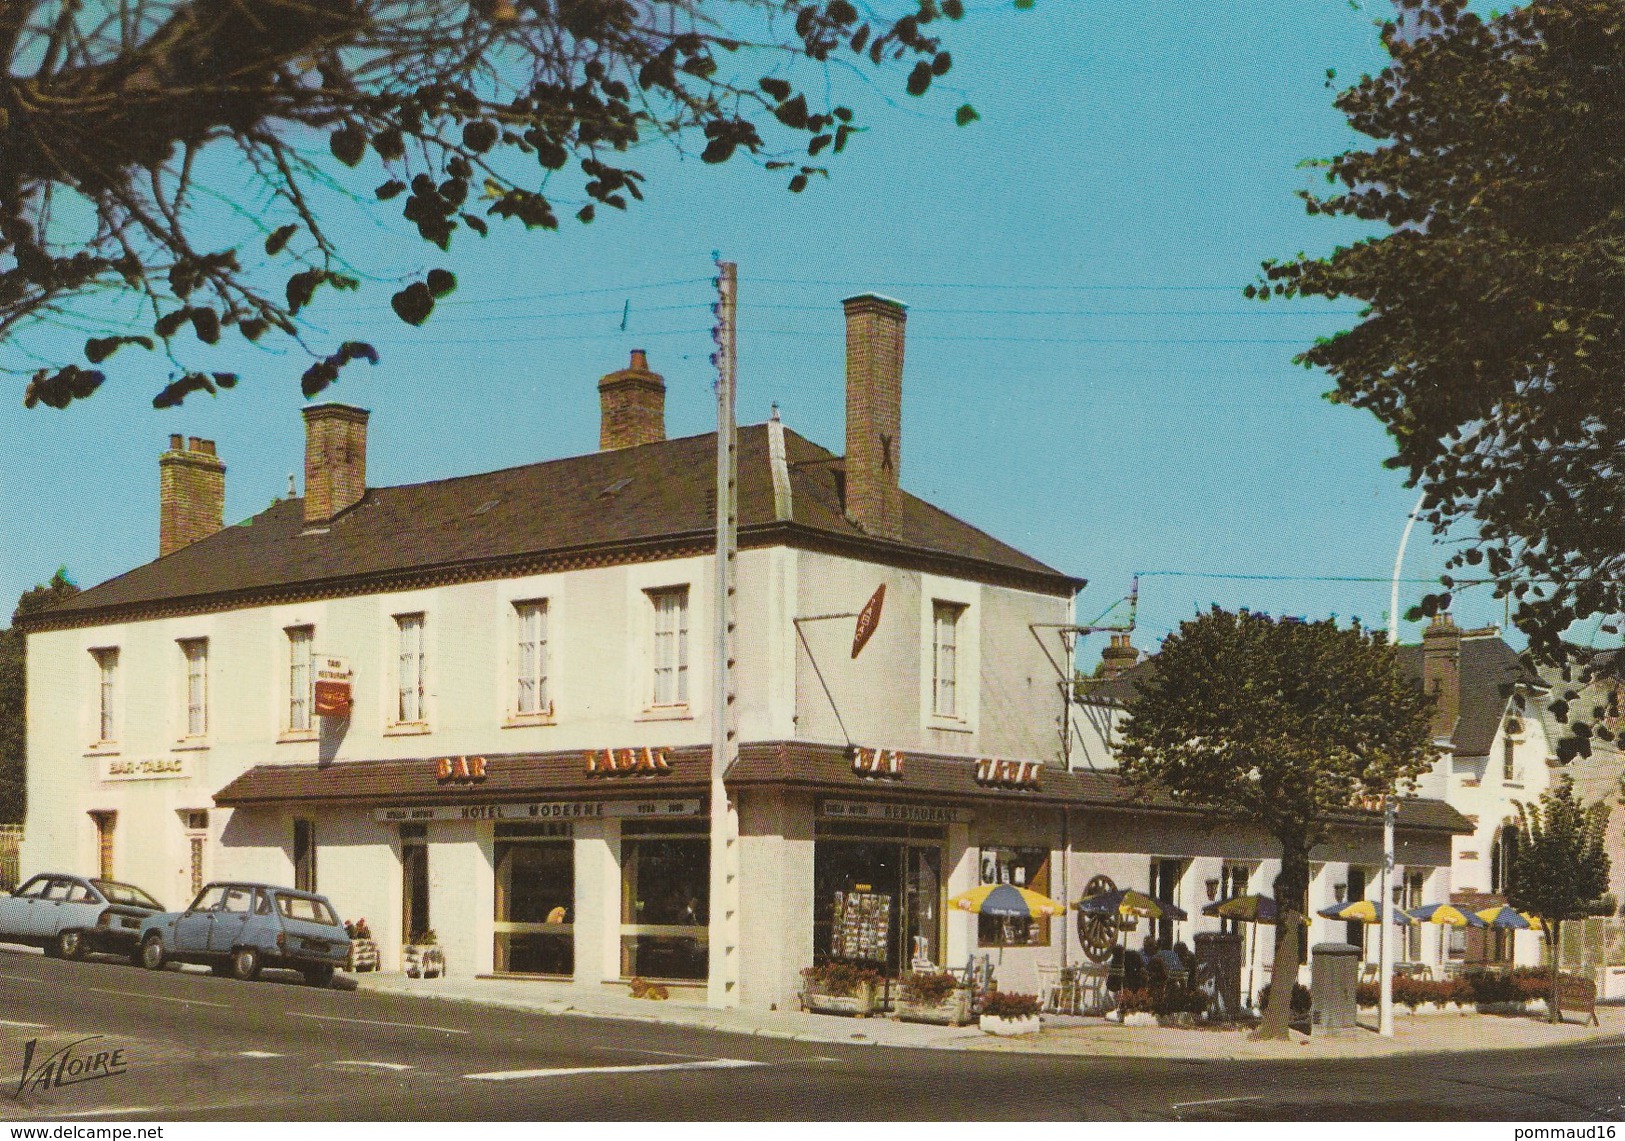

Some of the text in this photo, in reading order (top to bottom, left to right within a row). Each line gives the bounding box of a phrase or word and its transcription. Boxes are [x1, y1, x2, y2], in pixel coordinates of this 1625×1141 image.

[436, 756, 487, 781] BAR
[583, 747, 674, 775] TABAC
[852, 747, 906, 776] BAR
[461, 802, 604, 819] HOTEL MODERNE
